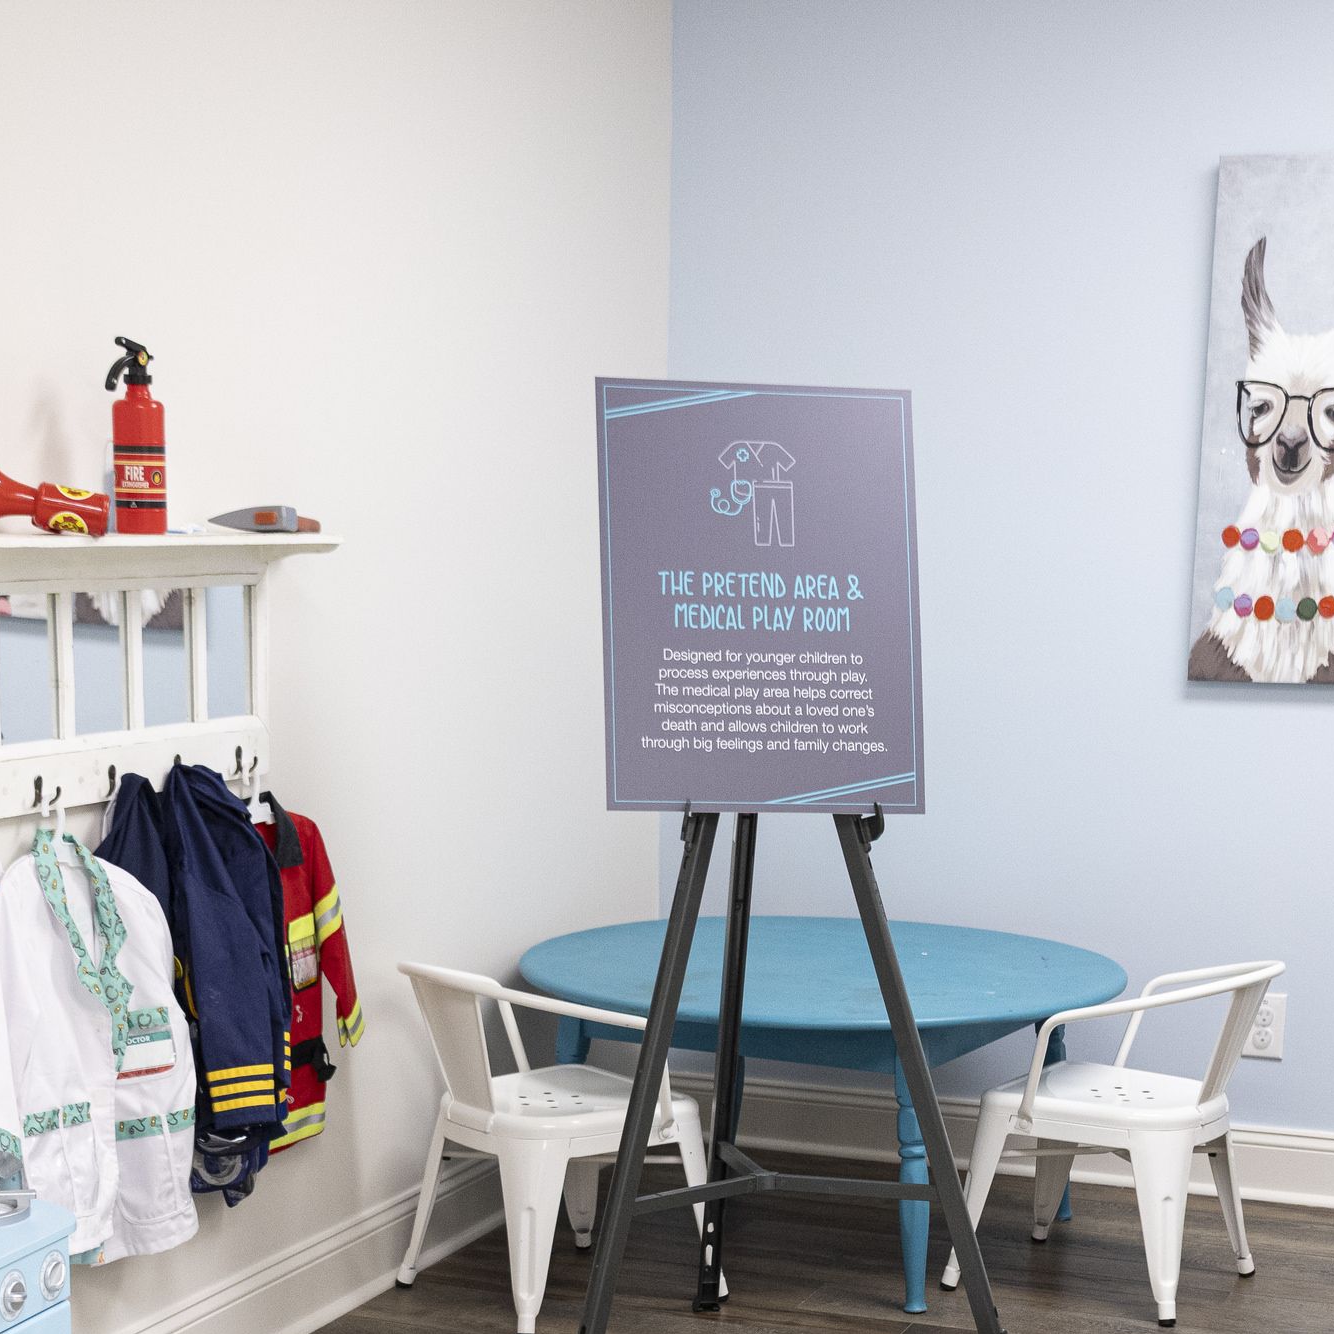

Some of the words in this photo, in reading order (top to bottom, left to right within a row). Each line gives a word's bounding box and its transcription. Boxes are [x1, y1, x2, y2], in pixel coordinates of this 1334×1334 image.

[125, 465, 145, 481] FIRE
[658, 570, 695, 596] THE
[702, 571, 786, 599] PRETEND
[794, 574, 840, 600] AREA
[846, 574, 864, 600] &
[674, 602, 746, 631] MEDICAL
[752, 604, 795, 632] PLAY
[803, 606, 850, 632] ROOM
[663, 647, 722, 664] Designed
[725, 649, 743, 662] for
[745, 652, 796, 666] younger
[799, 651, 847, 664] children
[850, 653, 863, 665] to
[658, 668, 709, 681] process
[712, 667, 787, 682] experiences
[789, 668, 837, 685] through
[841, 669, 868, 685] play.
[654, 682, 679, 696] The
[682, 684, 730, 697] medical
[734, 685, 760, 700] play
[763, 687, 790, 698] area
[793, 686, 827, 701] helps
[829, 688, 873, 700] correct
[654, 701, 752, 717] misconceptions
[755, 702, 791, 716] about
[794, 705, 803, 716] a
[806, 703, 839, 717] loved
[842, 704, 875, 717] one's
[661, 718, 697, 731] death
[700, 719, 725, 732] and
[728, 720, 767, 733] allows
[770, 720, 818, 734] children
[821, 722, 835, 734] to
[837, 722, 869, 734] work
[641, 735, 690, 752] through
[693, 736, 713, 752] big
[716, 737, 763, 753] feelings
[766, 738, 790, 751] and
[793, 738, 829, 754] family
[832, 739, 888, 755] changes.
[127, 1035, 151, 1044] OCTOR
